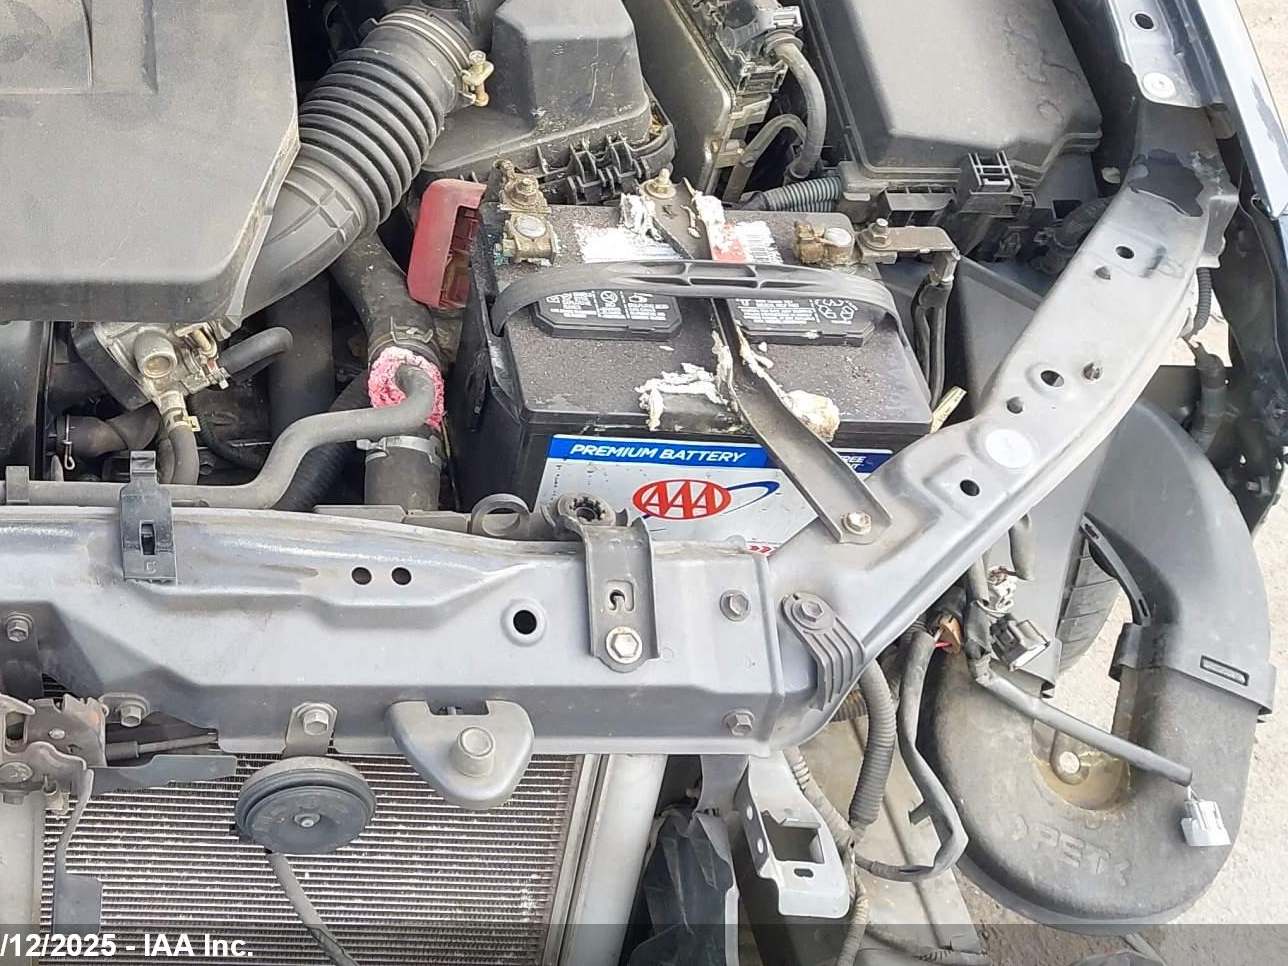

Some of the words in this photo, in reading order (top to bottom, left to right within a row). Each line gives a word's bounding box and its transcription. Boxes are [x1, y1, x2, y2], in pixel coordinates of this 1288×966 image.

[570, 444, 659, 459] PREMIUM
[659, 448, 746, 462] BATTERY
[839, 455, 867, 464] REE
[639, 480, 724, 520] AAA
